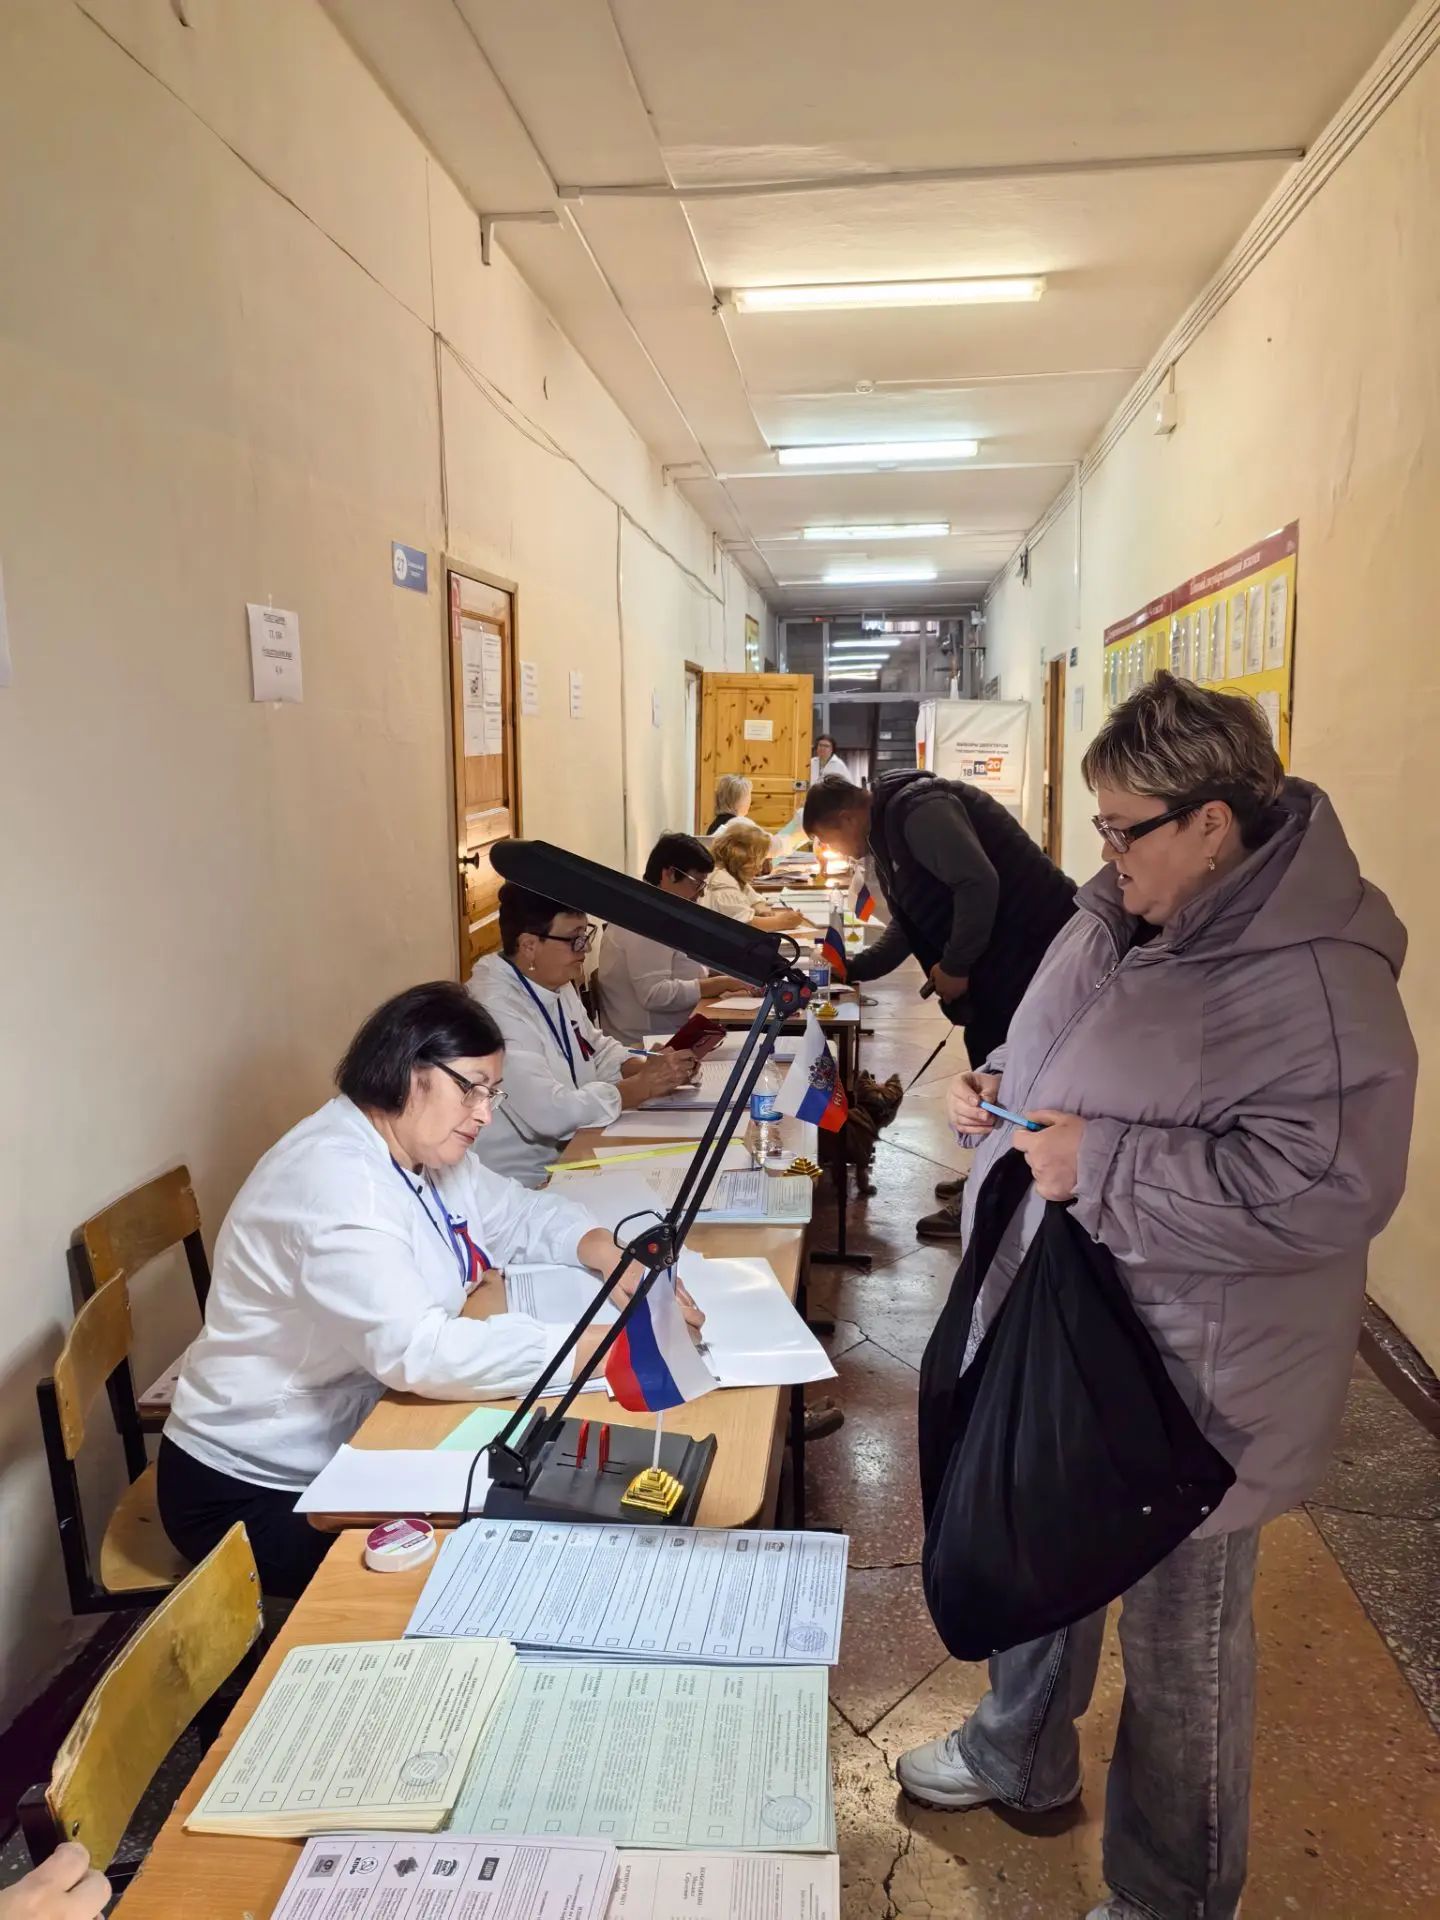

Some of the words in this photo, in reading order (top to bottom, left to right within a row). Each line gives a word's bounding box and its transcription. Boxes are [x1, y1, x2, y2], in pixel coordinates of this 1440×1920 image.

[963, 768, 972, 776] 18
[988, 760, 1000, 769] 20
[350, 1857, 362, 1875] КПРФ
[483, 1861, 495, 1878] ЛДПР
